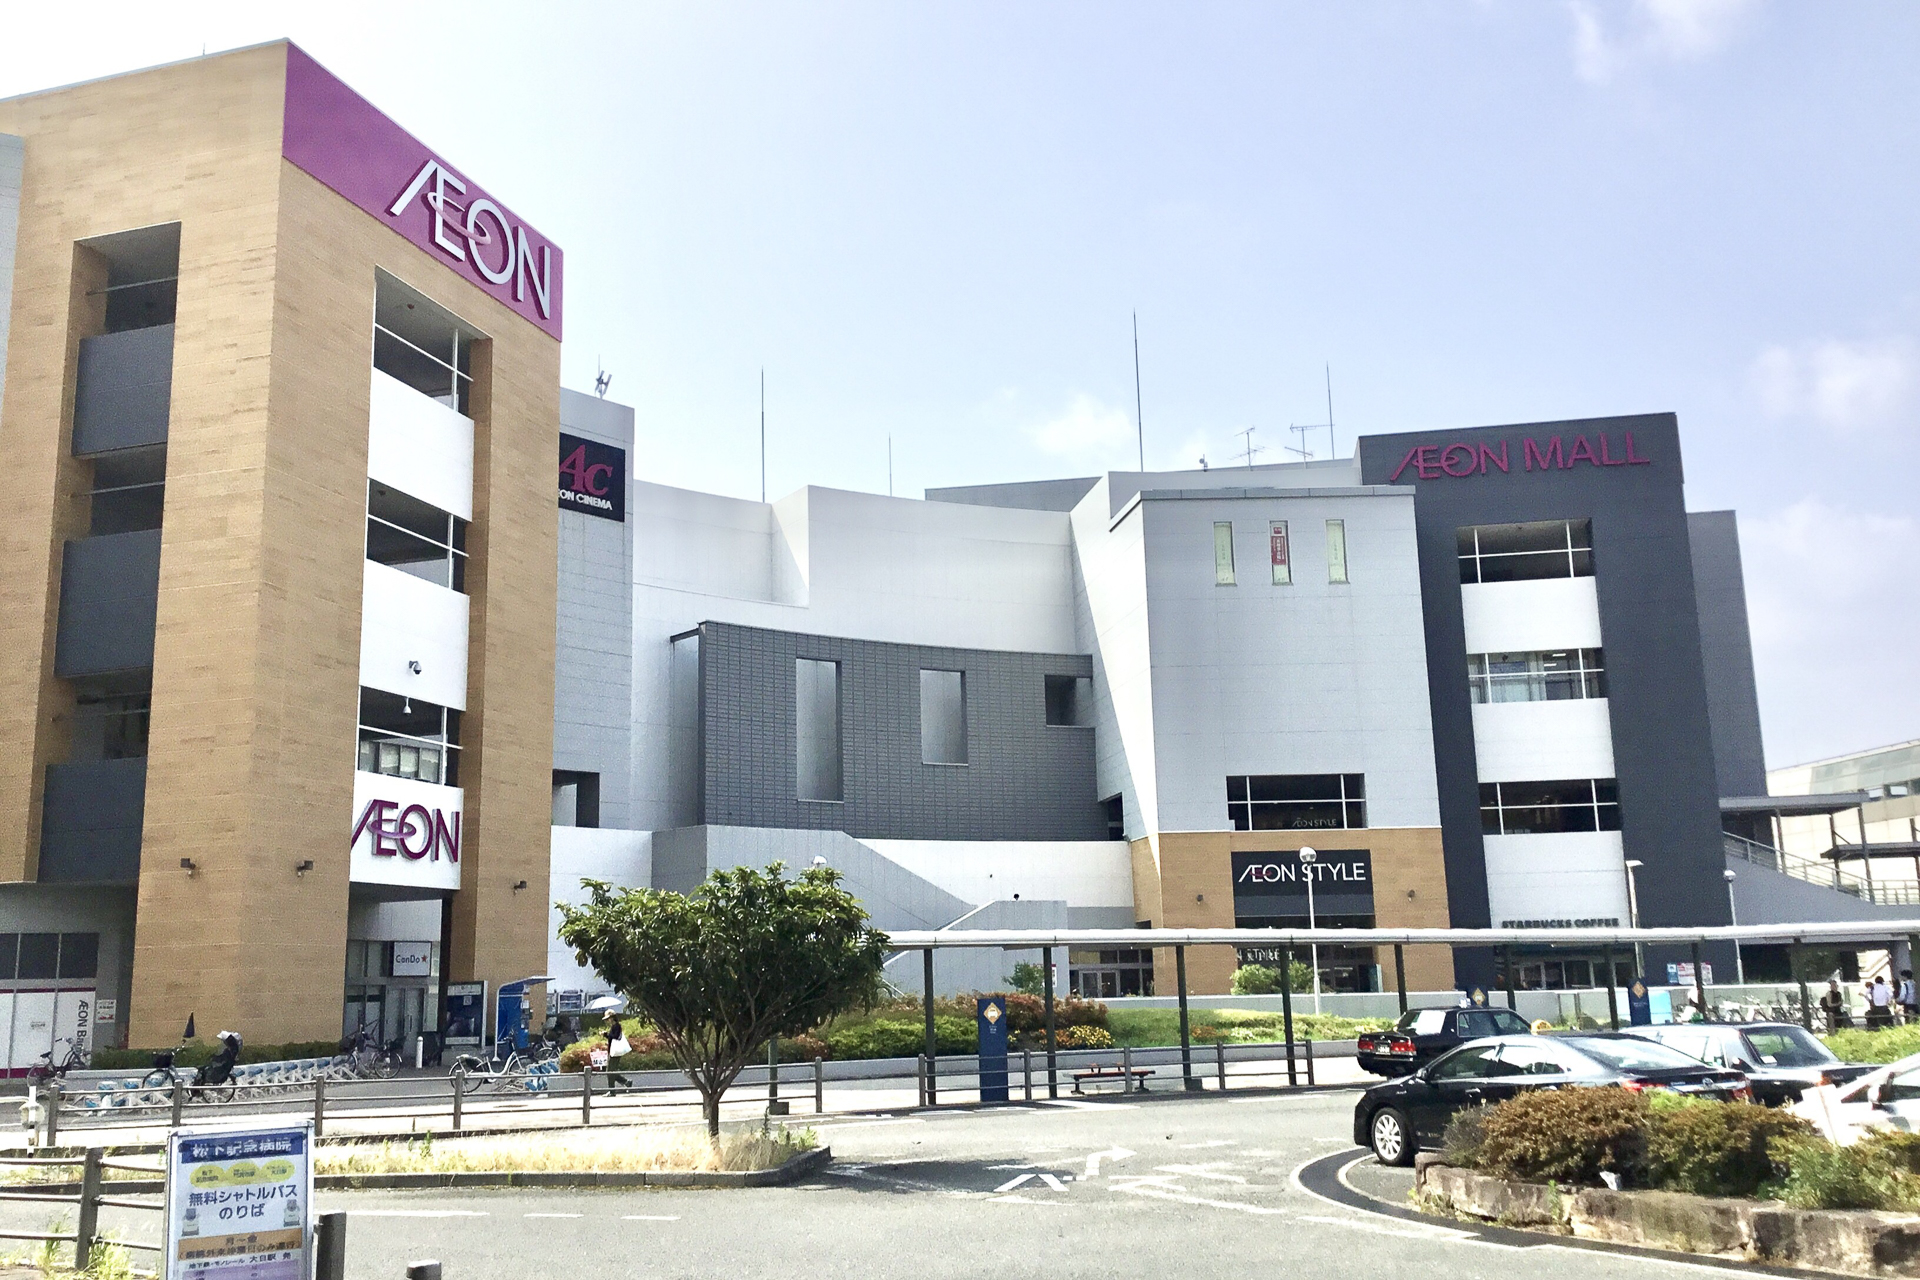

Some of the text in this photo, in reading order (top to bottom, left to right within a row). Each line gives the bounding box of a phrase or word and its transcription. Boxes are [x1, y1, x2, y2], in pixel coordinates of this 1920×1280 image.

[1522, 431, 1650, 472] MALL
[576, 493, 613, 511] CINEMA
[1301, 862, 1366, 882] STYLE
[1502, 918, 1619, 929] STARBUCKS COFFEE
[395, 953, 421, 964] CanDo
[188, 1184, 298, 1207] 無料シャトルバス
[219, 1203, 265, 1220] のりば
